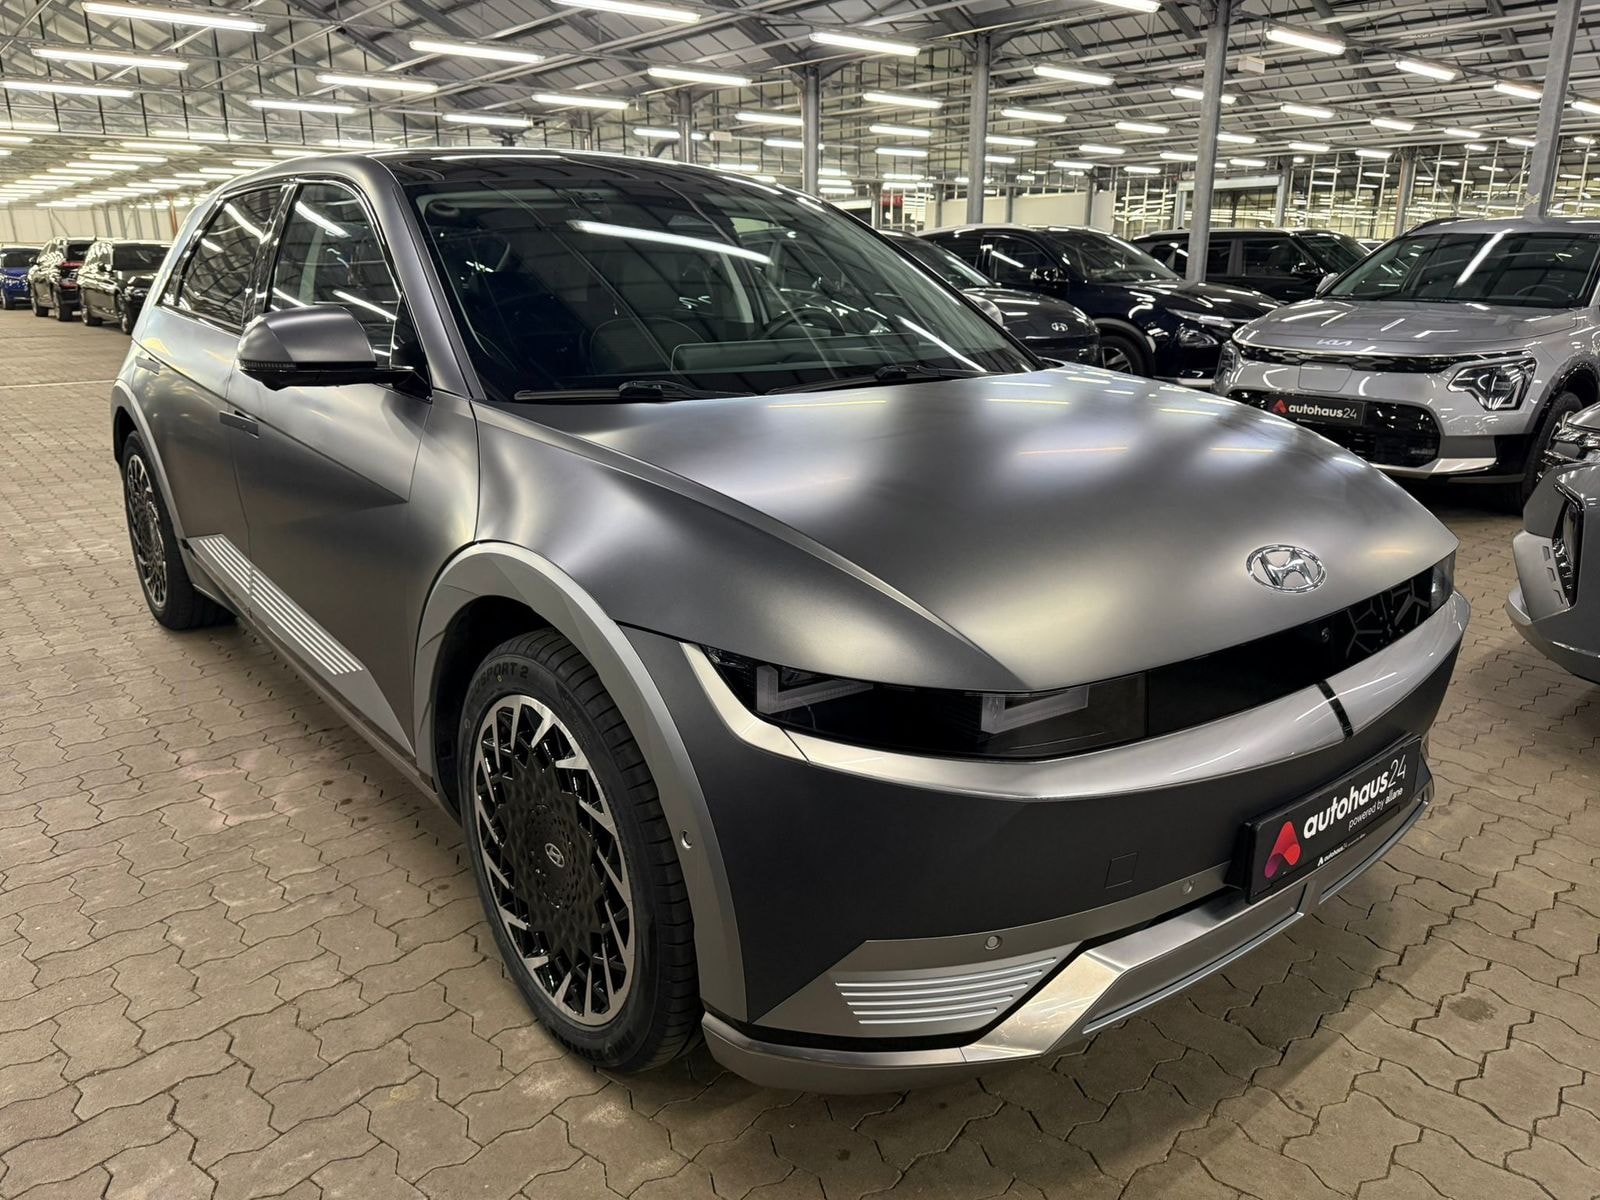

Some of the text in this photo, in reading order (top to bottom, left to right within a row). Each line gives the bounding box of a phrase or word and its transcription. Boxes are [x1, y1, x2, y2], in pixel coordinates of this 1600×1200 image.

[1288, 404, 1357, 419] autohaus24
[1303, 754, 1406, 839] autohaus24
[1348, 787, 1403, 832] powered by allane
